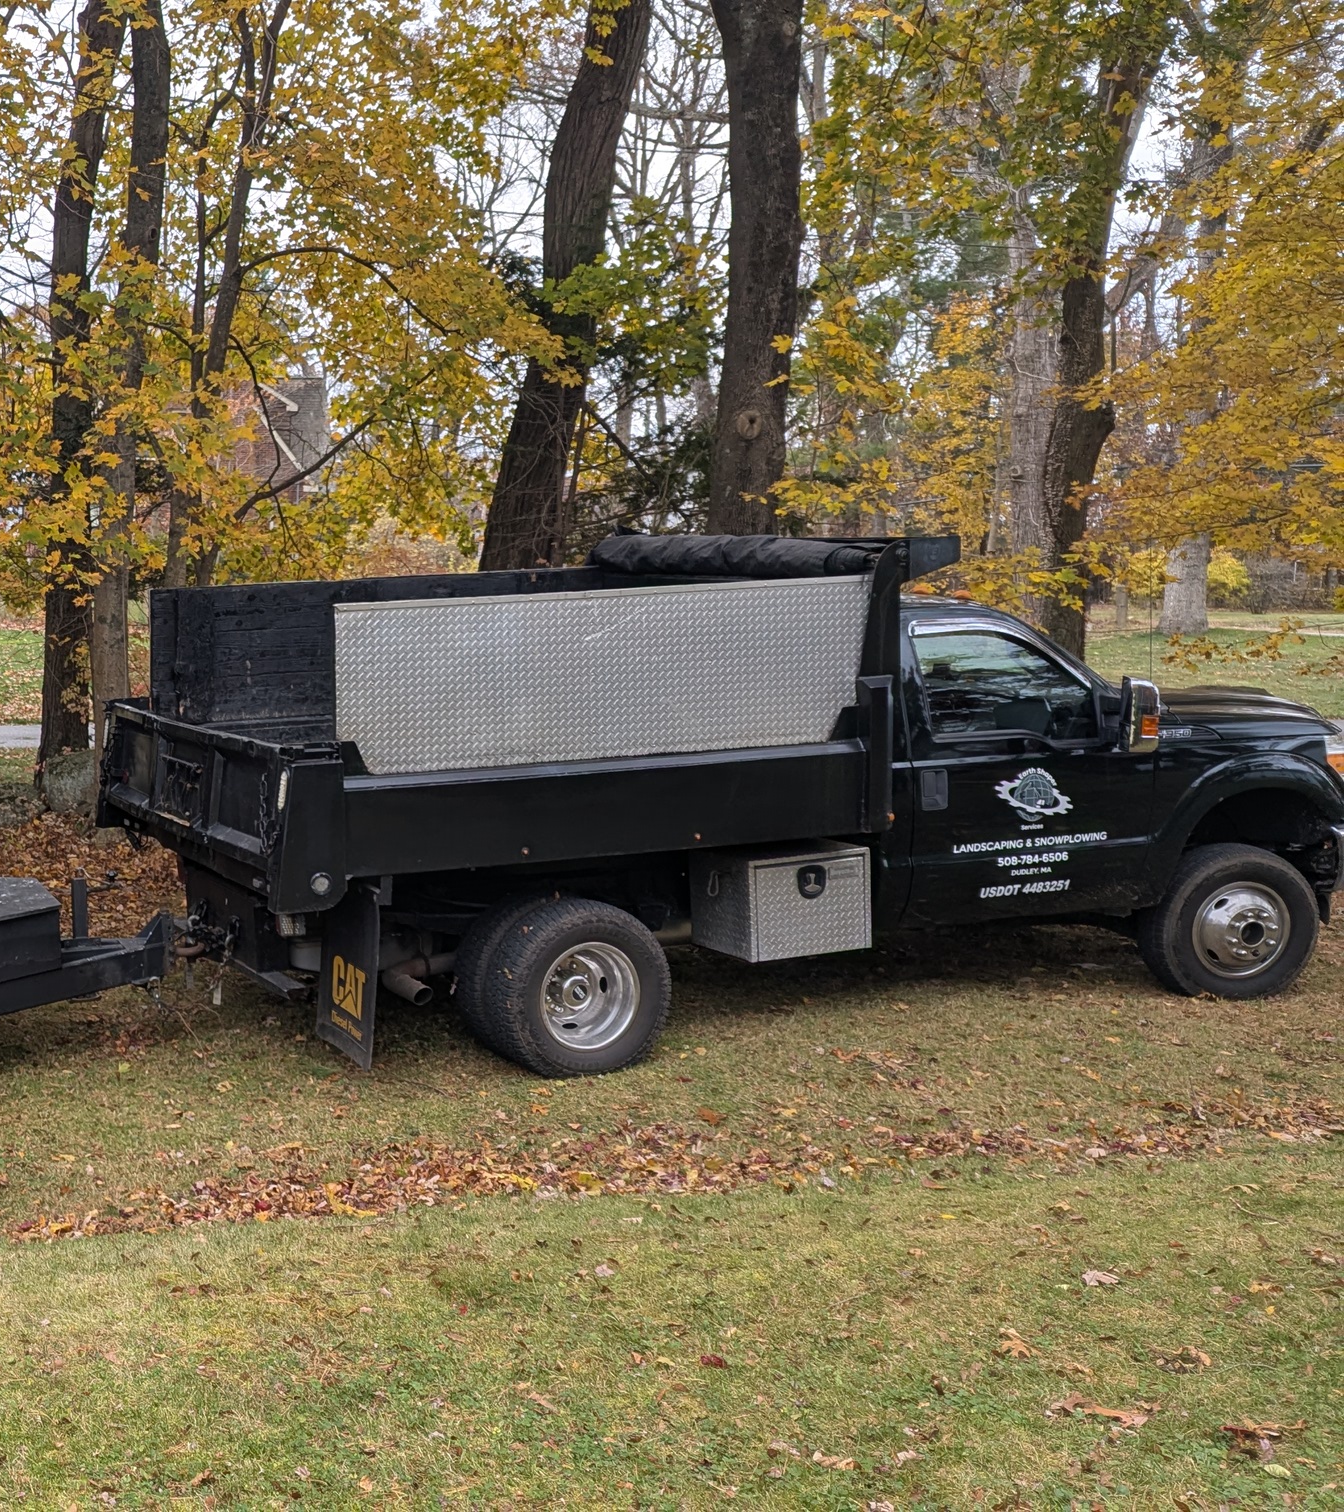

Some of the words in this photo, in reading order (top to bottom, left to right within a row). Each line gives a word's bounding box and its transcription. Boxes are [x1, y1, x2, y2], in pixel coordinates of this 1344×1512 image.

[1017, 767, 1037, 780] Earth
[1020, 823, 1044, 831] Services
[952, 838, 1024, 854] LANDSCAPING
[1025, 838, 1033, 847] &
[1034, 831, 1108, 847] SNOWPLOWING
[997, 851, 1069, 867] 508-784-6506
[1040, 866, 1052, 874] MA
[979, 884, 1021, 899] USDOT
[1021, 879, 1071, 894] 4483251
[331, 955, 365, 1021] CAT
